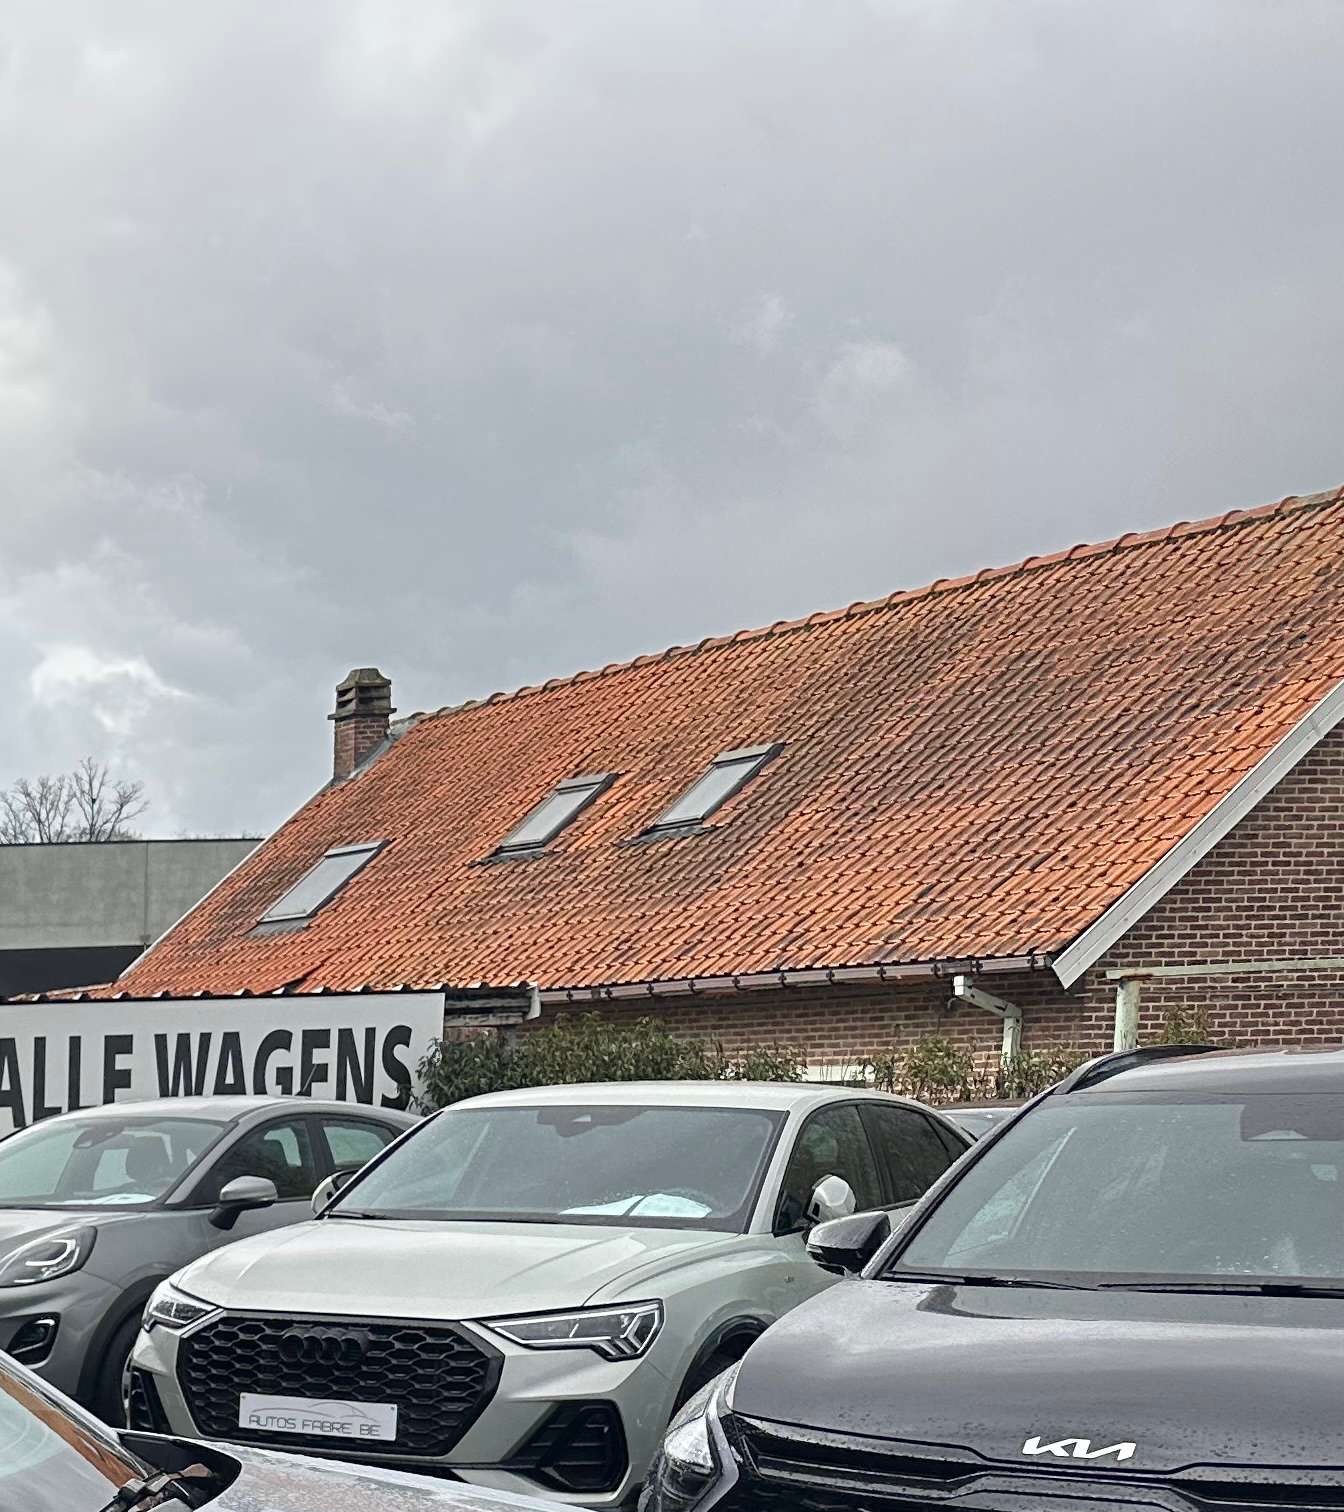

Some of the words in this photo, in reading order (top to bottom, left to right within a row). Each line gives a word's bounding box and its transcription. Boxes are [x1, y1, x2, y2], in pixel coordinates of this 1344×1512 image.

[154, 1025, 413, 1111] WAGENS
[248, 1414, 297, 1430] AUTOS
[301, 1419, 353, 1435] FABRE
[359, 1423, 382, 1437] BE
